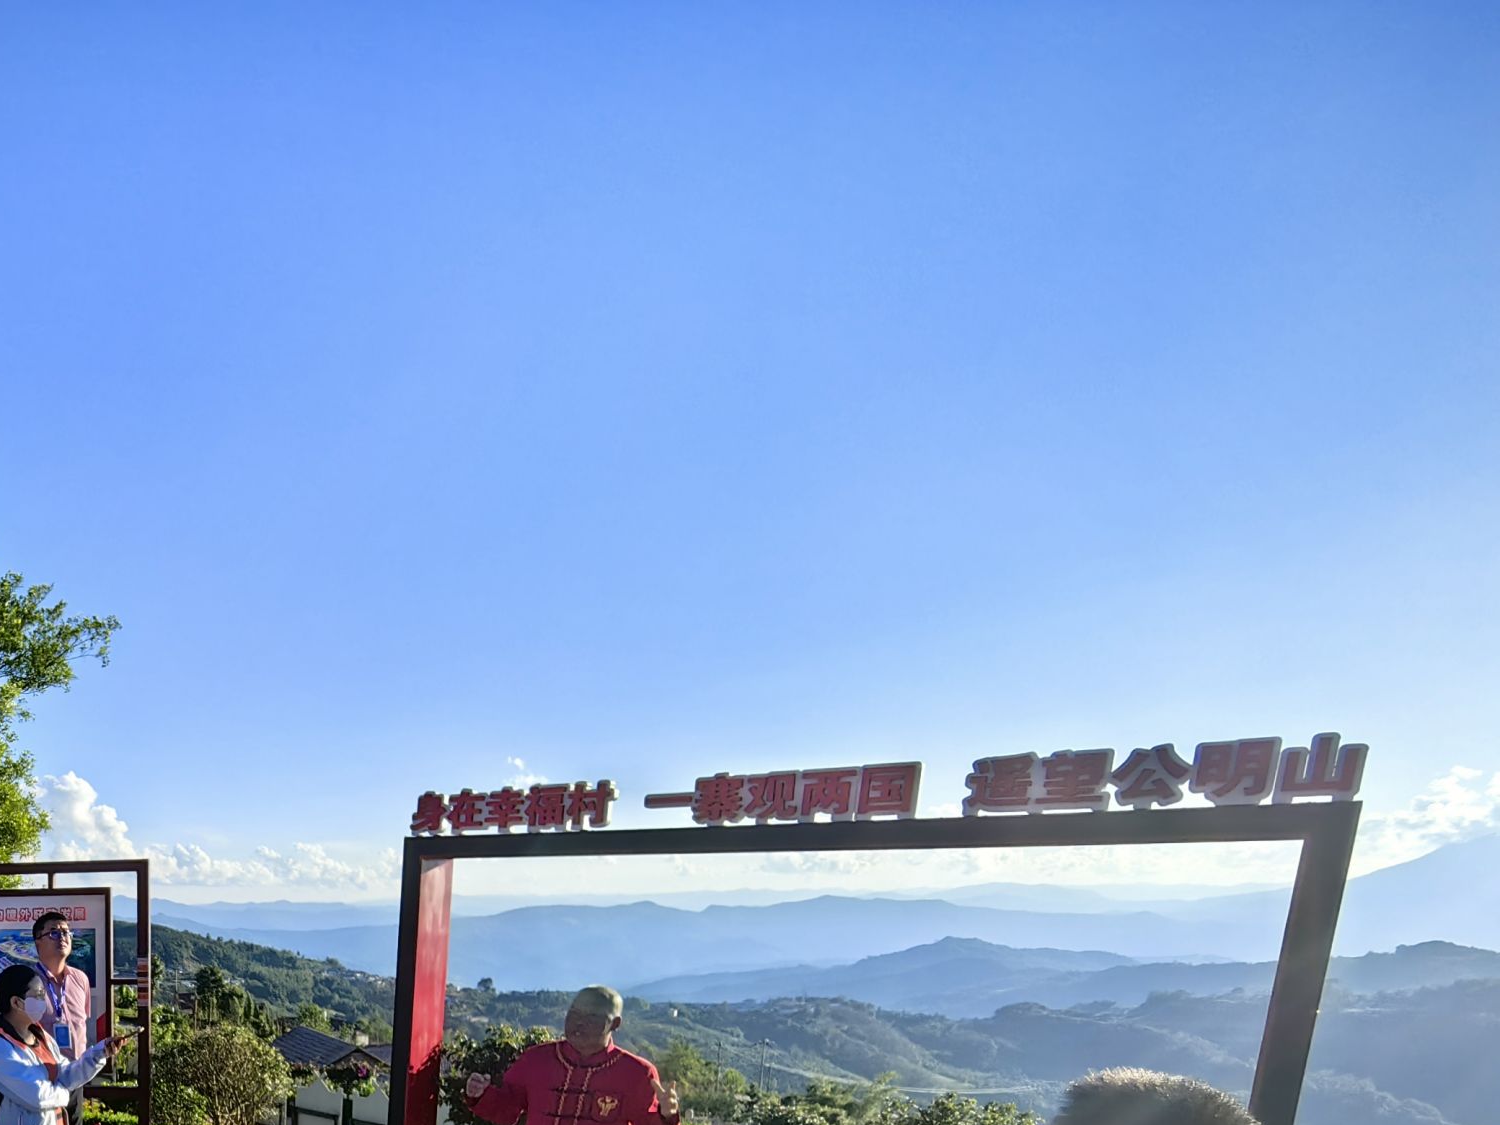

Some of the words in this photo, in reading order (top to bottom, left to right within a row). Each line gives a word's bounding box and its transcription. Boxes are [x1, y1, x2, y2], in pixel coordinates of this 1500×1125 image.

[411, 779, 618, 835] 身在幸福村
[644, 761, 921, 824] 一寨观两国
[963, 733, 1368, 812] 遥望公明山
